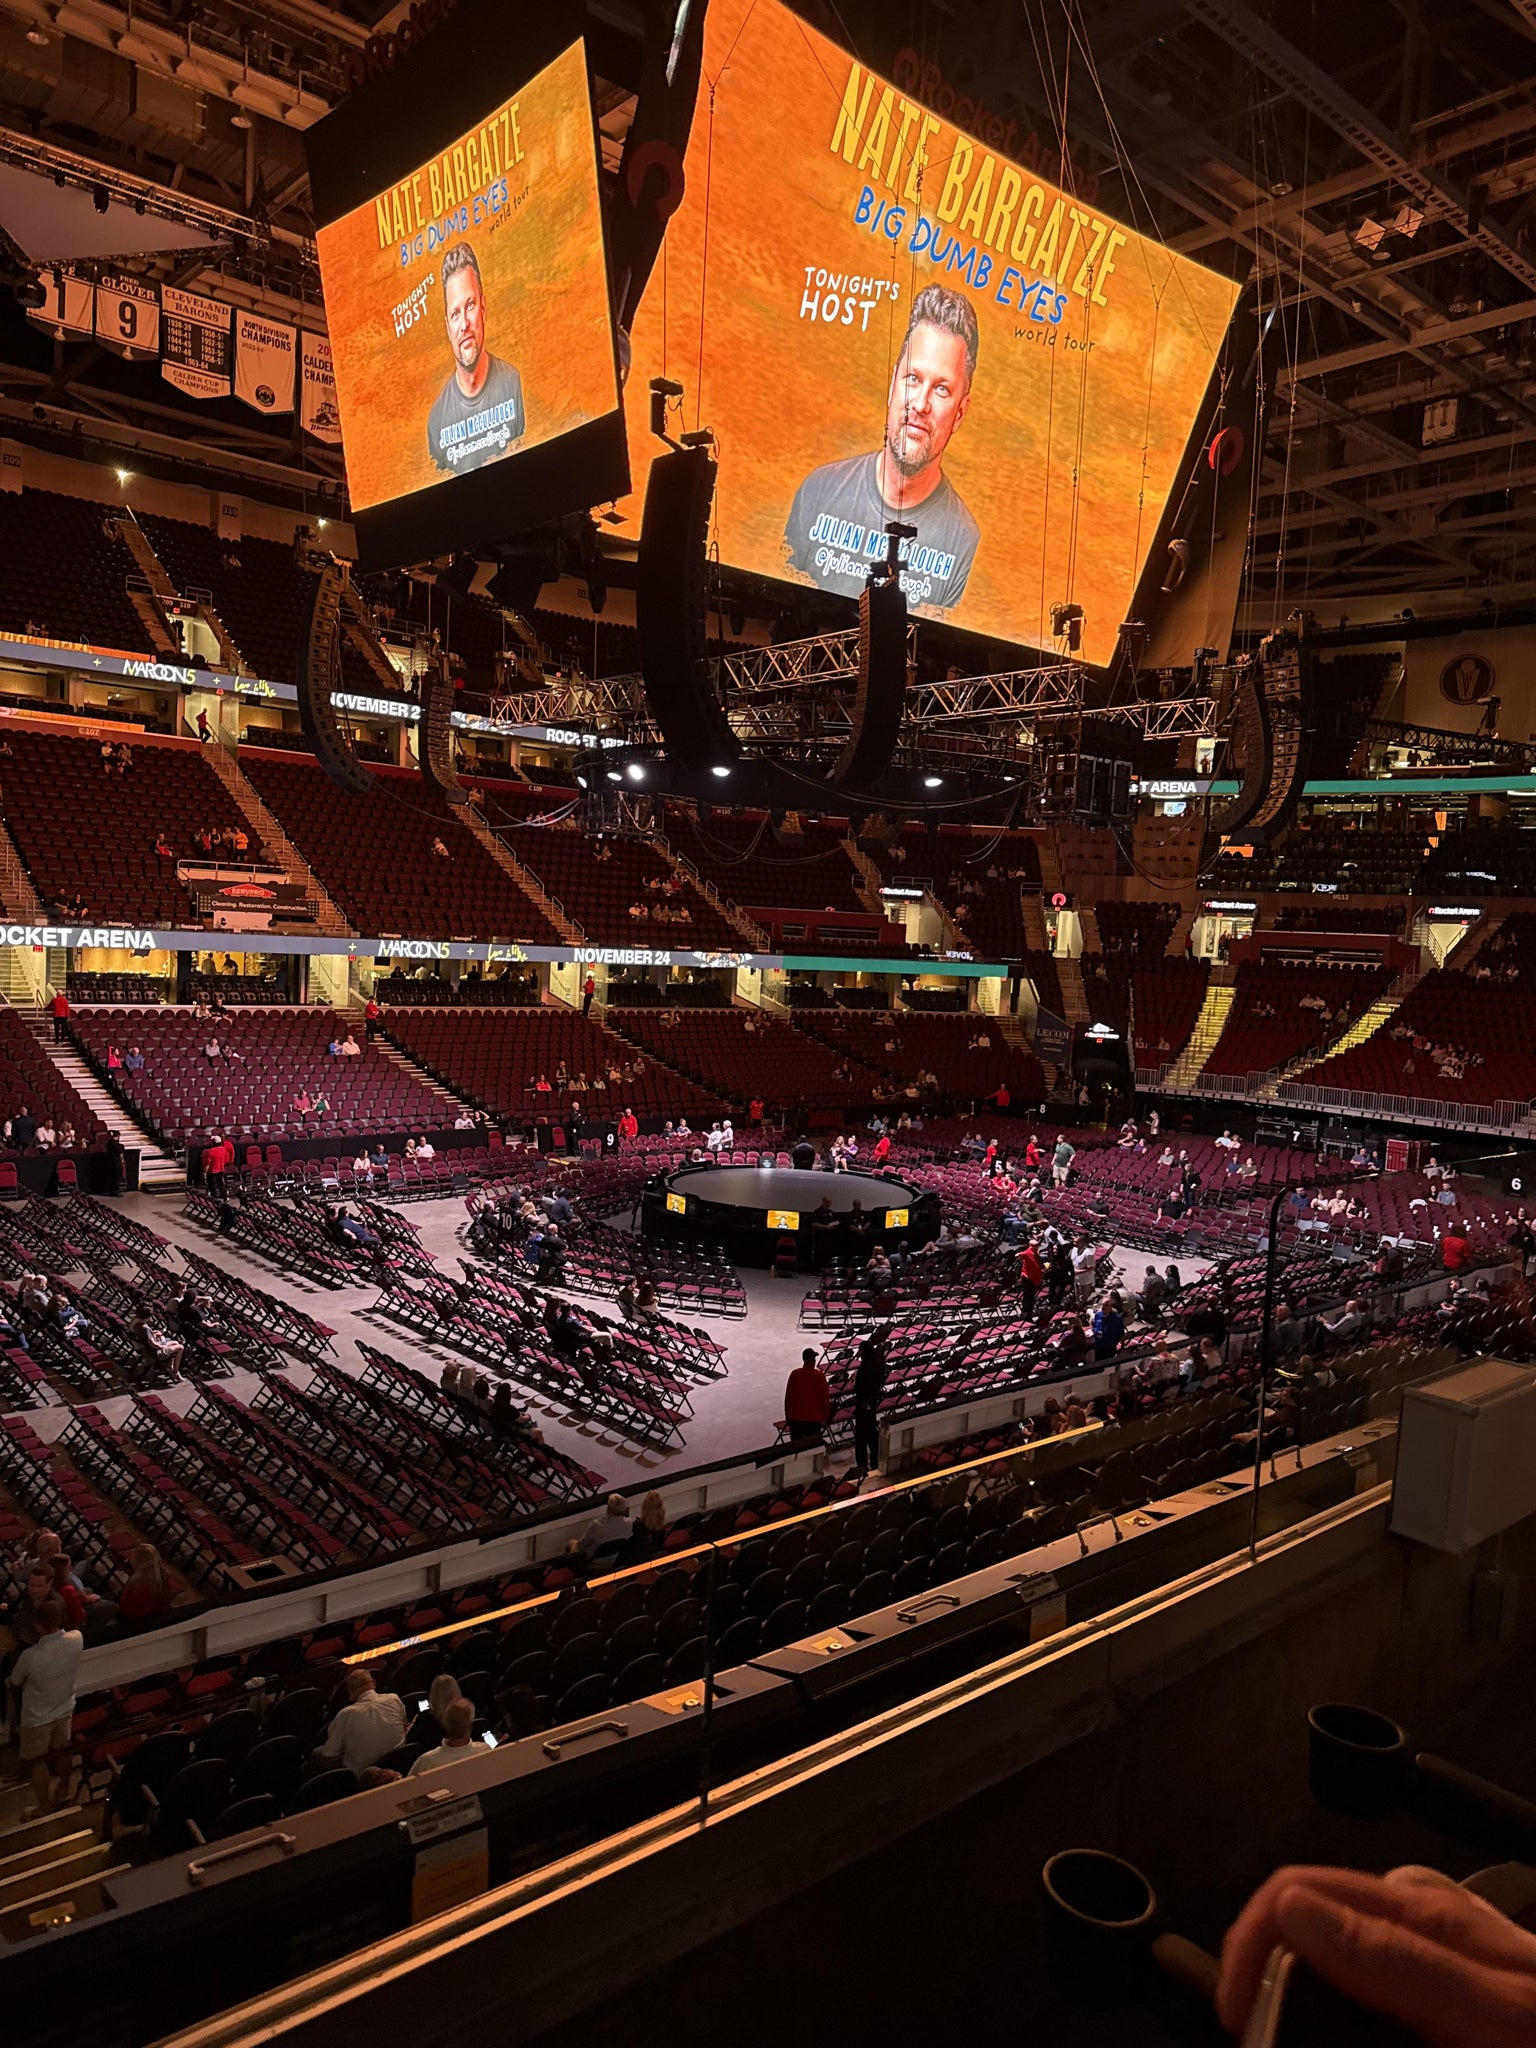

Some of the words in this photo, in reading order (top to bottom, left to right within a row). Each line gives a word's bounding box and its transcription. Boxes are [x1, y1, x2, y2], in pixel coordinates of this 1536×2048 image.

[376, 173, 426, 249] NATE
[428, 101, 525, 219] BARGATZE
[830, 62, 941, 205] NATE
[936, 135, 1127, 307] BARGATZE
[401, 234, 424, 267] BIG
[427, 206, 468, 251] DUMB
[473, 178, 508, 226] EYES
[488, 207, 512, 235] world
[513, 185, 530, 211] tour
[854, 185, 906, 239] BIG
[908, 217, 993, 289] DUMB
[995, 266, 1068, 325] EYES
[101, 276, 157, 301] GLOVER
[391, 272, 435, 318] TONIGHT'S
[804, 266, 900, 301] TONIGHT'S
[164, 288, 229, 317] CLEVELAND
[174, 302, 220, 323] BARONS
[799, 289, 876, 332] HOST
[118, 300, 137, 339] 9
[394, 294, 428, 339] HOST
[241, 327, 292, 352] CHAMPIONS
[243, 319, 262, 332] NORTH
[263, 326, 290, 340] DIVISION
[1013, 325, 1058, 347] world
[1063, 331, 1096, 354] tour
[204, 378, 220, 388] CUP
[440, 420, 467, 449] JULIAN
[809, 513, 866, 553] JULIAN
[1150, 781, 1197, 793] ARENA
[231, 888, 265, 896] SERVPRO
[211, 900, 237, 908] Cleaning.
[238, 901, 272, 909] Restoration.
[272, 904, 308, 912] Construction.
[76, 929, 157, 949] ARENA
[574, 947, 653, 966] NOVEMBER
[654, 950, 671, 966] 24
[1036, 1028, 1070, 1040] LECOM
[1039, 1103, 1046, 1114] 8
[606, 1133, 615, 1146] 9
[1292, 1130, 1301, 1142] 7
[994, 1160, 1002, 1172] 5
[1511, 1177, 1522, 1191] 6
[501, 1212, 512, 1230] 10
